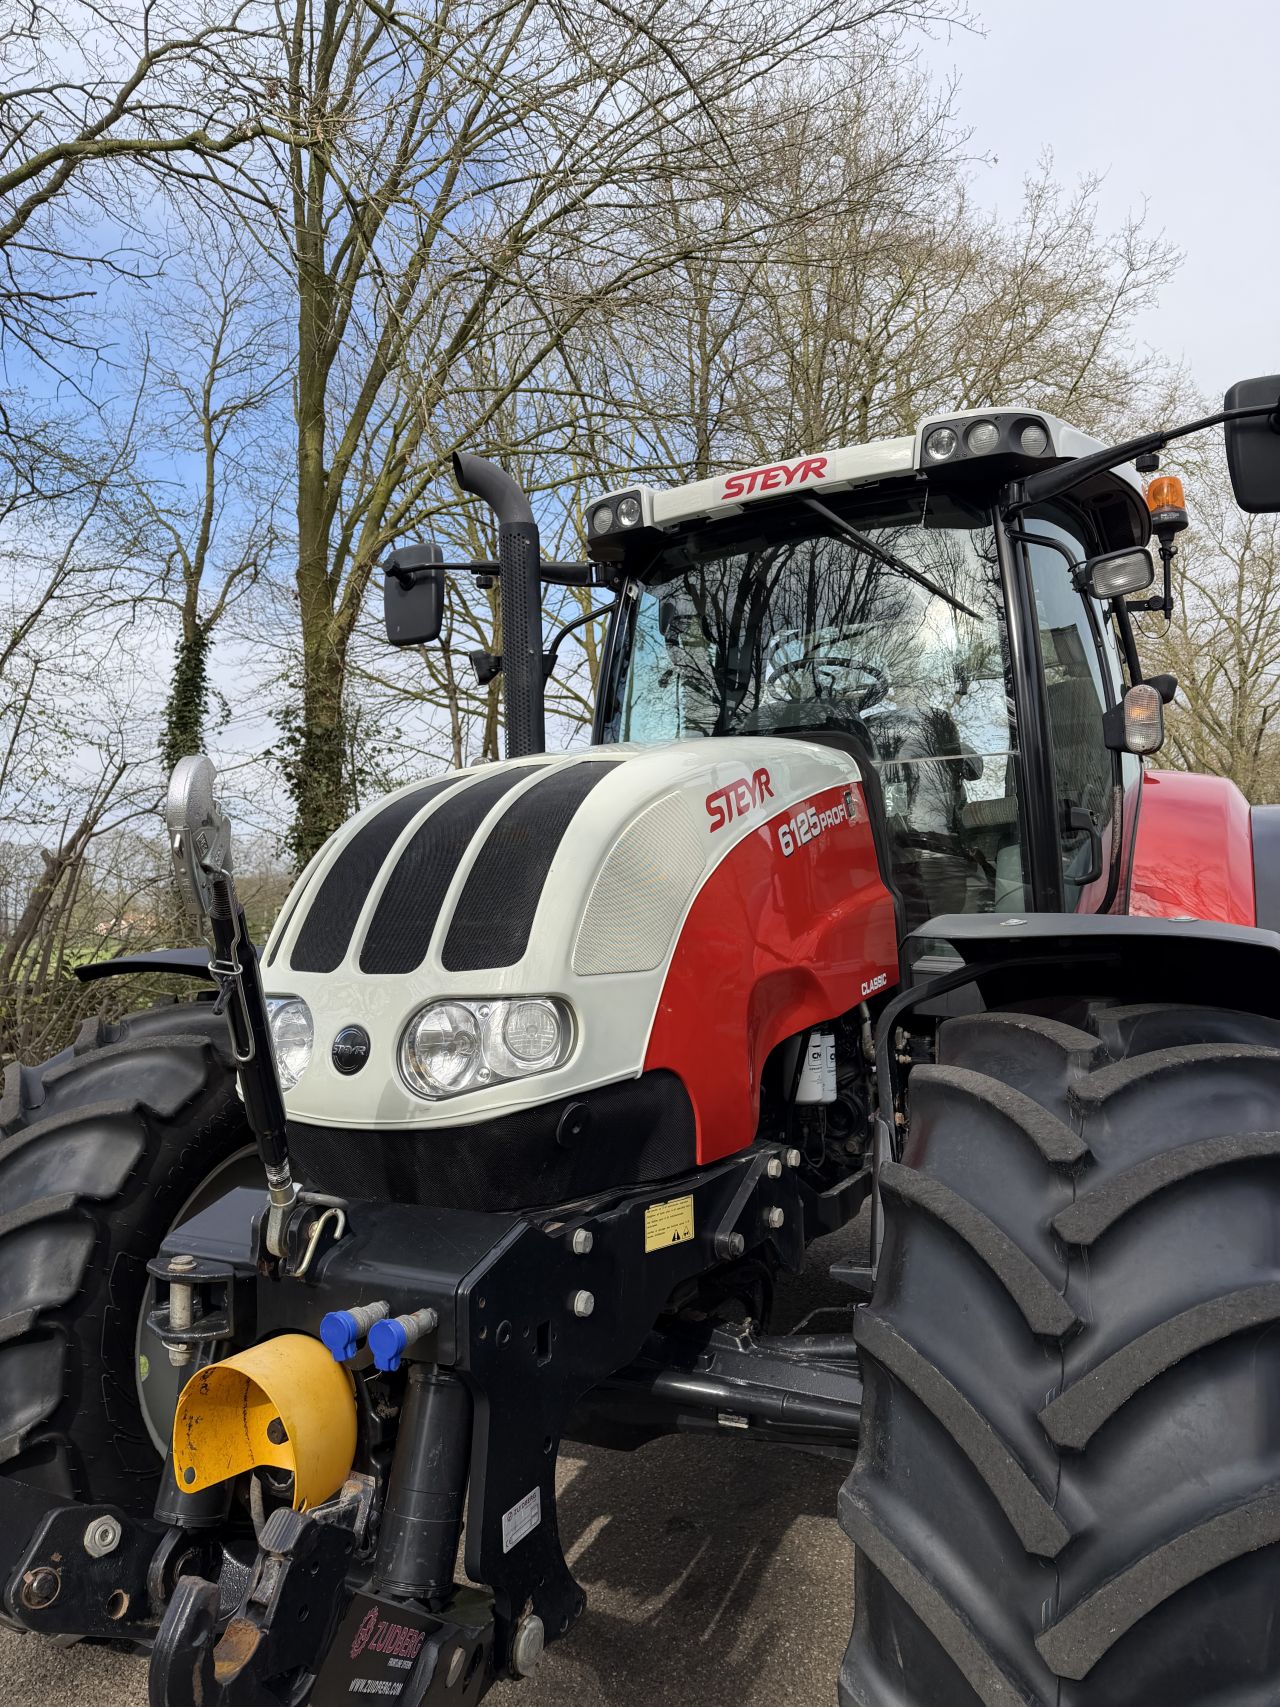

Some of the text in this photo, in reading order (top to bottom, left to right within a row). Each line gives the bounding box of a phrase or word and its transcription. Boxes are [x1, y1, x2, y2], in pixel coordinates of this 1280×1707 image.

[721, 457, 828, 500] STEYR
[705, 767, 775, 833] STEYR
[777, 803, 848, 858] 6125 PROFI
[861, 973, 887, 996] CLASSIC
[367, 1621, 426, 1659] ZUIDBERG
